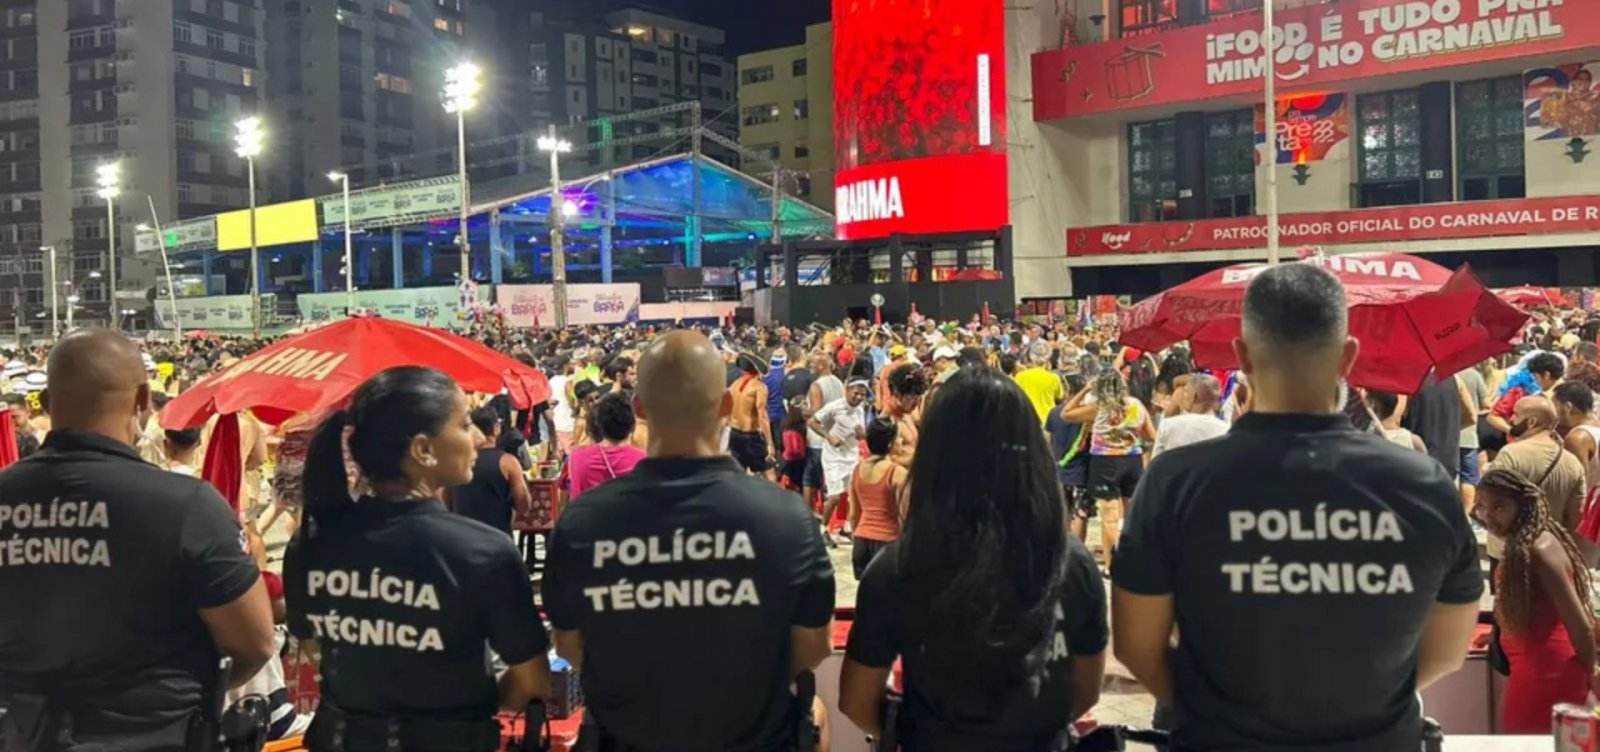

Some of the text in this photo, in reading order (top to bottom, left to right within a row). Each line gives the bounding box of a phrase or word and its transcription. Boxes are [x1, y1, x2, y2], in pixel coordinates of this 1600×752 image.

[1206, 22, 1307, 59] iFOOD
[1321, 10, 1342, 42] É
[1358, 0, 1461, 34] TUDO
[1318, 41, 1364, 70] NO
[1372, 10, 1563, 61] CARNAVAL
[1213, 222, 1333, 240] PATROCNADOR
[1336, 217, 1404, 234] OFICIAL
[1409, 216, 1436, 229] DO
[1440, 209, 1546, 228] CARNAVAL
[1552, 207, 1580, 222] DE
[1229, 503, 1404, 542] POLÍCIA
[593, 528, 756, 568] POLÍCIA
[308, 567, 440, 610] POLÍCIA
[584, 577, 760, 612] TÉCNICA
[1221, 556, 1414, 594] TÉCNICA
[306, 609, 444, 651] TÉCNICA
